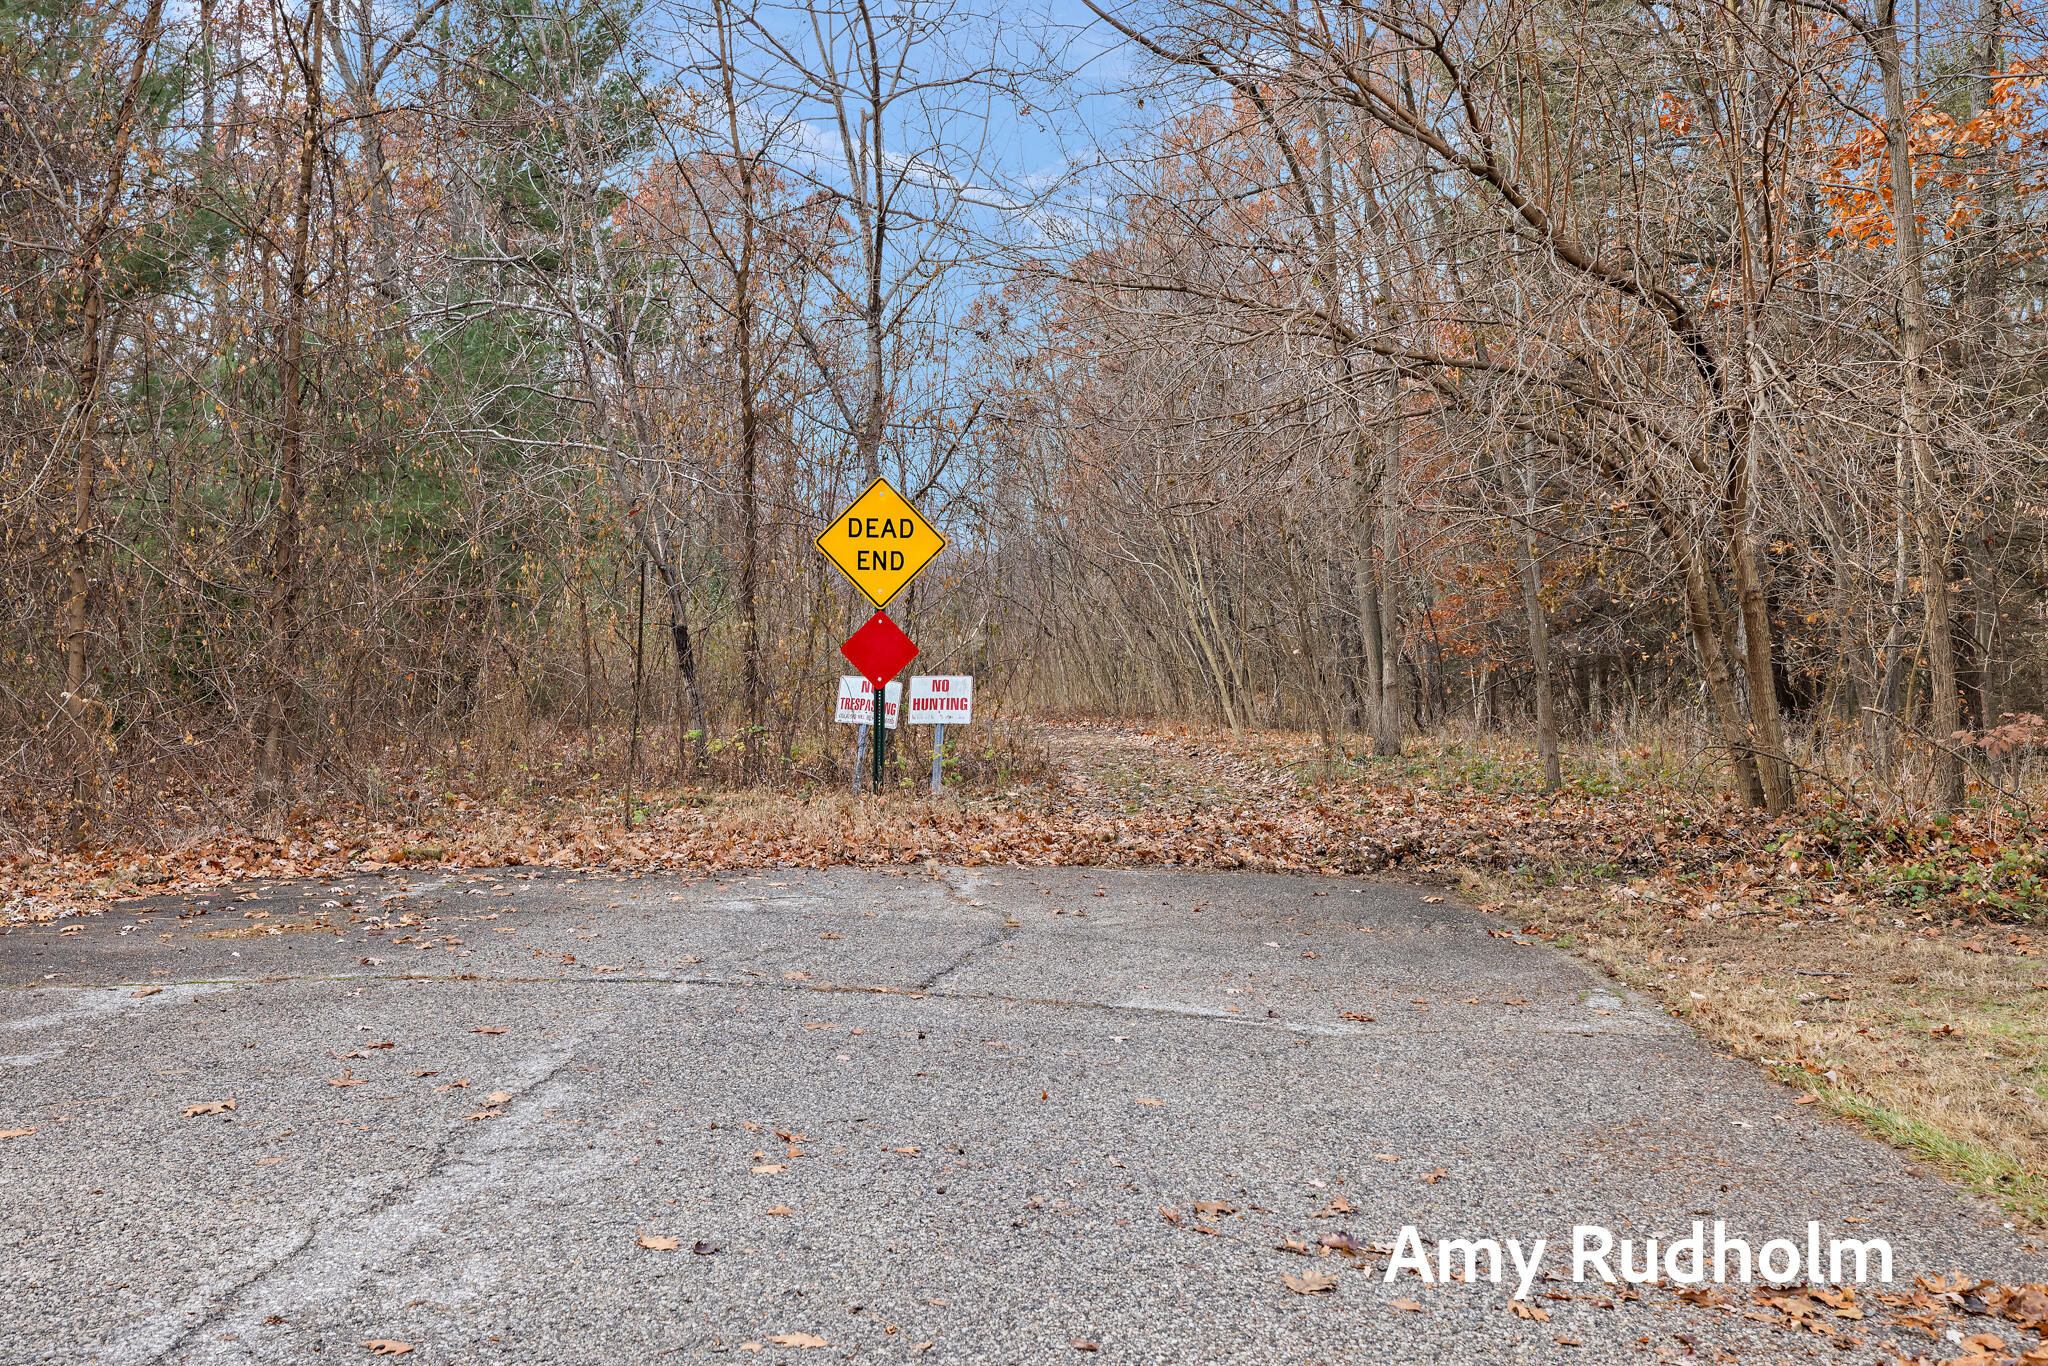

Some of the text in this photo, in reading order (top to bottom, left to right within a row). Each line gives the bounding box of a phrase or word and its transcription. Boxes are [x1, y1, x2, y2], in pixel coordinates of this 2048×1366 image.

[848, 518, 914, 538] DEAD
[857, 550, 904, 571] END
[932, 679, 950, 692] NO
[840, 697, 897, 716] TRESPASNG
[912, 697, 968, 711] HUNTING
